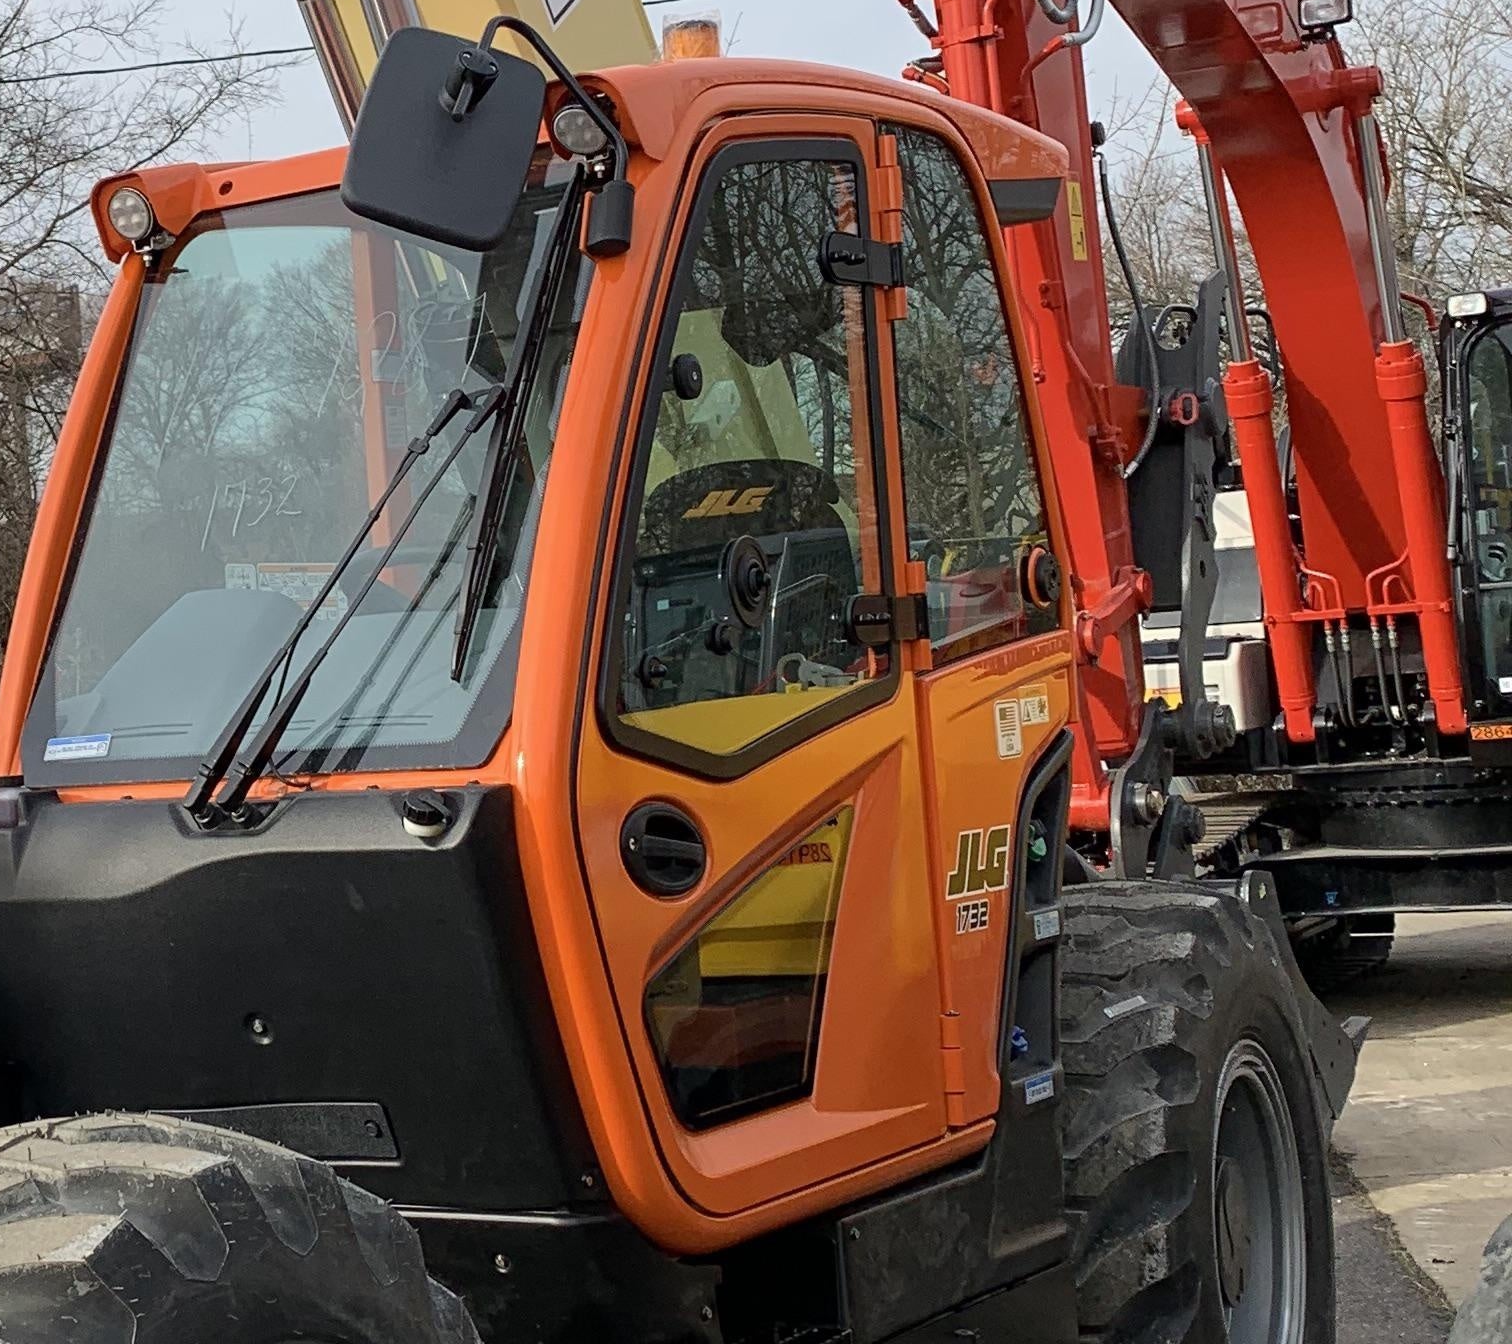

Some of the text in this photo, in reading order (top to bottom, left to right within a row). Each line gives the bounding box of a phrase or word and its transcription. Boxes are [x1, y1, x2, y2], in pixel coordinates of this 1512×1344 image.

[679, 484, 776, 521] JLG
[946, 824, 1010, 900] JLG
[956, 899, 989, 934] 1732
